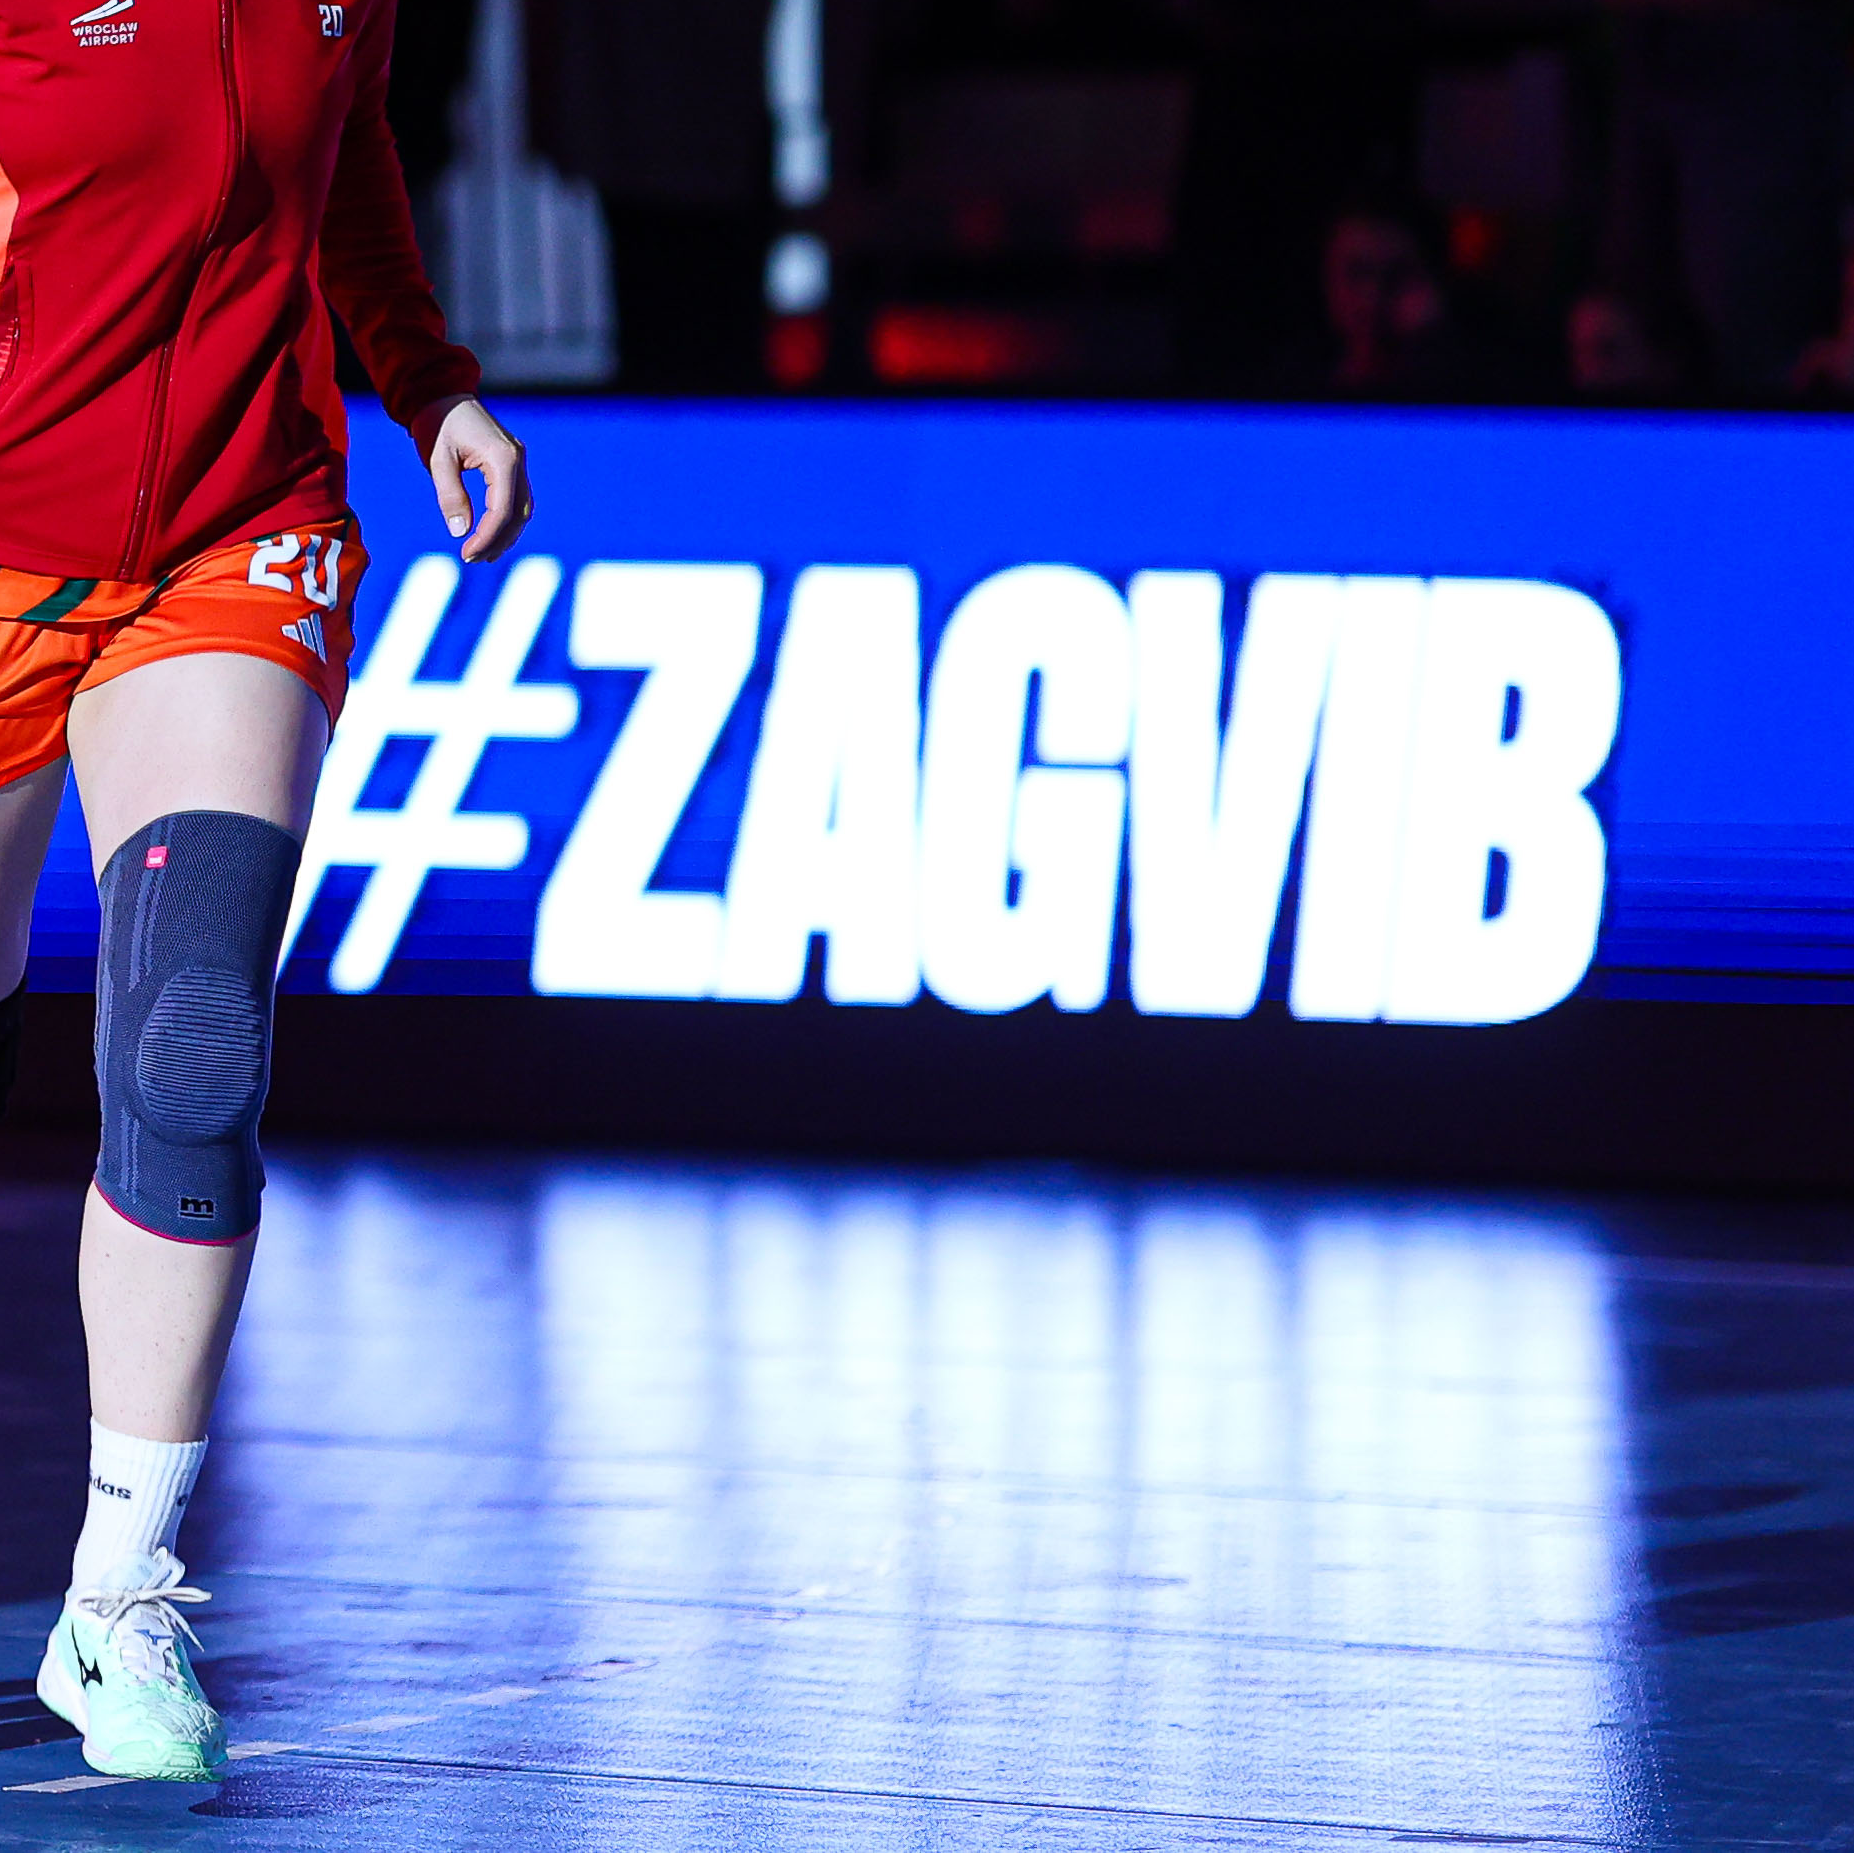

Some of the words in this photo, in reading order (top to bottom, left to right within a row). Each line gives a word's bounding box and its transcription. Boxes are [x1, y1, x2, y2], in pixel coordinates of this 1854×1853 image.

[72, 22, 138, 36] WROCLAW
[318, 4, 343, 36] 20
[79, 33, 136, 47] AIRPORT
[247, 533, 342, 610] 20
[276, 554, 1623, 1026] #ZAGVIB
